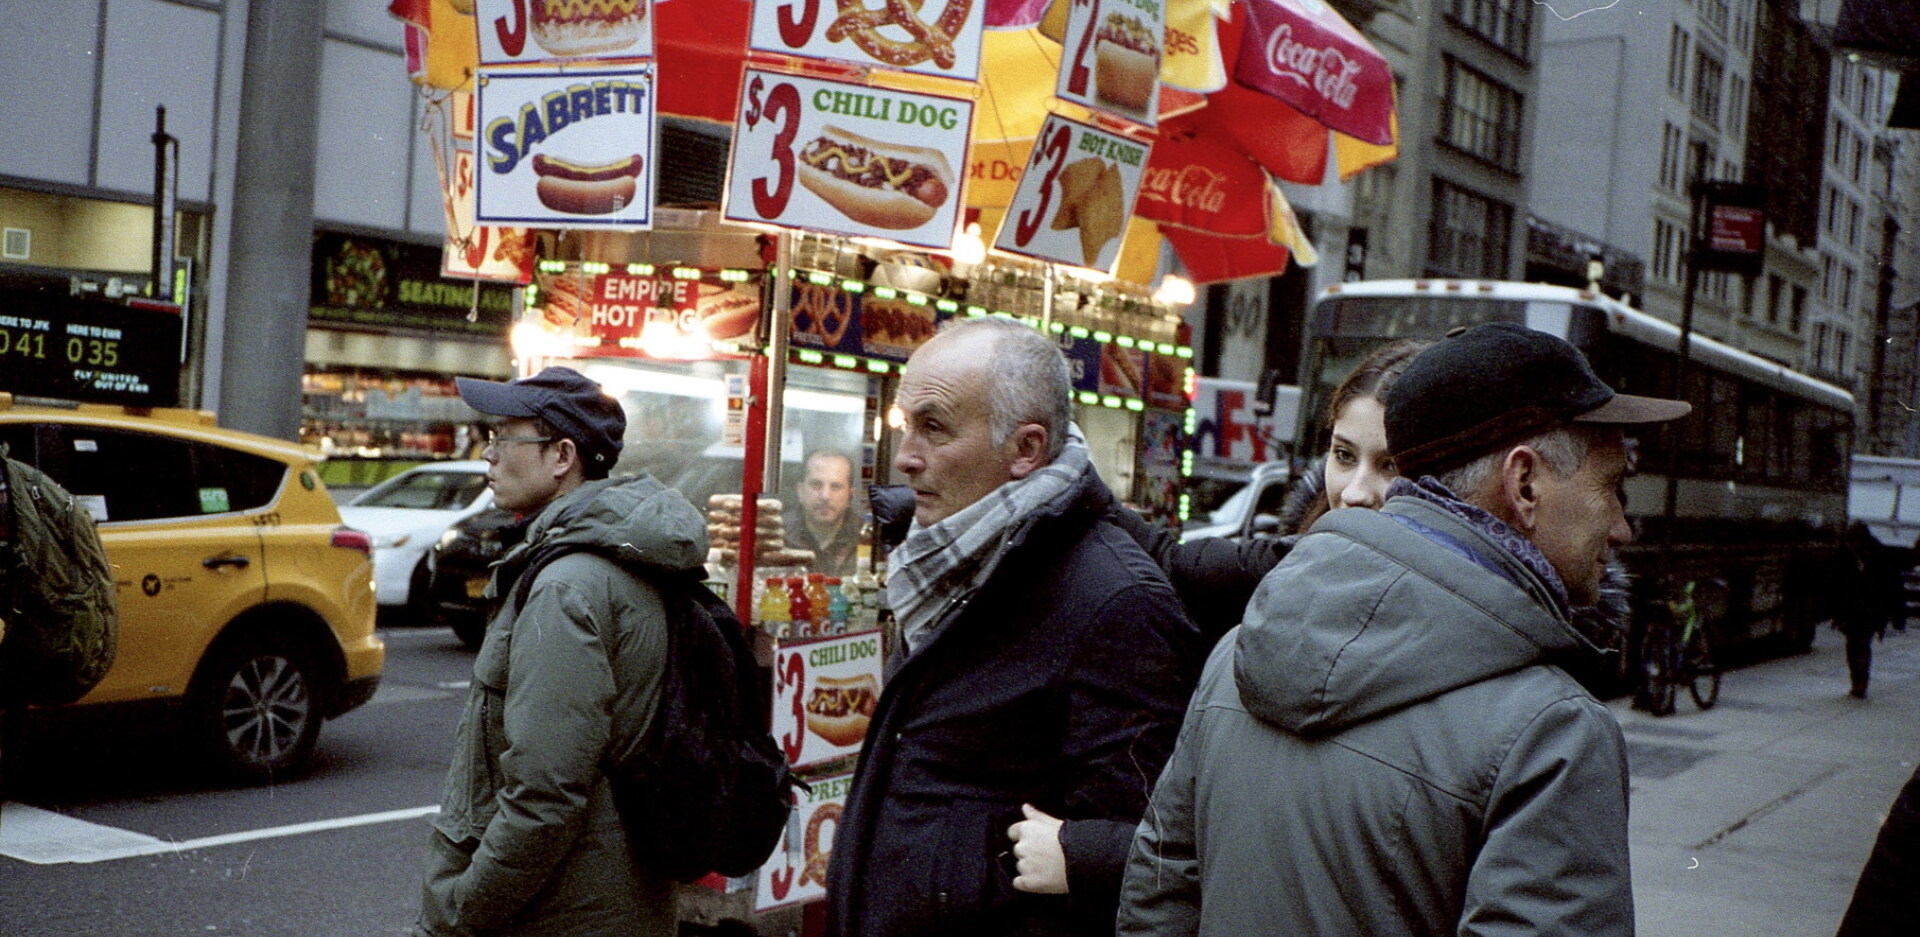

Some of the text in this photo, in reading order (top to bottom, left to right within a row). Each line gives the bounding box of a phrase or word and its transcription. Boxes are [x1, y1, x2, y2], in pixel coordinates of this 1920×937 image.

[1266, 23, 1361, 111] Coca-Cola
[812, 88, 958, 130] CHILI DOG
[485, 79, 645, 174] SABRETT
[1078, 131, 1103, 156] HOT
[991, 160, 1024, 182] Do
[1140, 164, 1226, 215] ca-Cola
[592, 305, 639, 327] HOT
[15, 332, 45, 359] 41
[87, 340, 118, 367] 35
[1191, 388, 1275, 464] dEx
[809, 638, 877, 668] CHILI DOG
[808, 777, 853, 803] PRET
